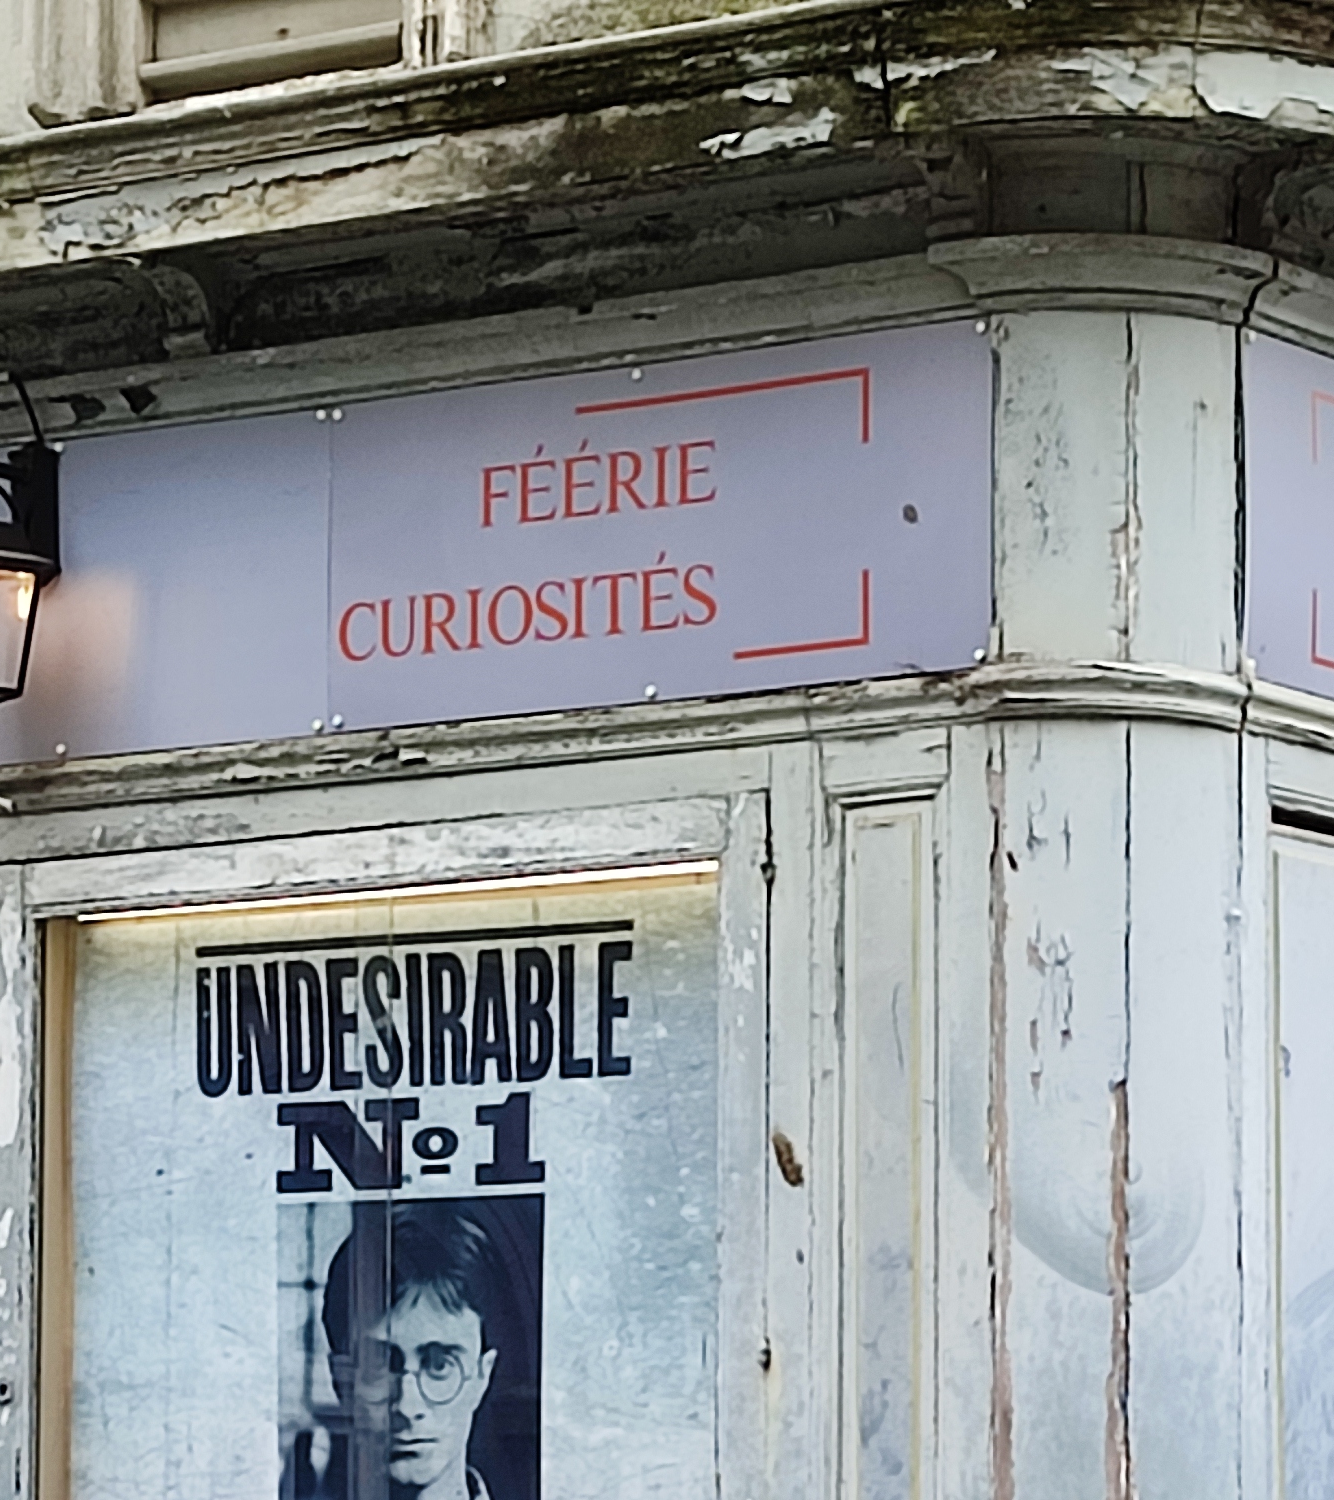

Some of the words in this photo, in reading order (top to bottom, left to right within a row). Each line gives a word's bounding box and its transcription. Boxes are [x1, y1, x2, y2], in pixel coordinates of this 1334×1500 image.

[480, 438, 717, 527] FÉÉRIE
[338, 550, 718, 661] CURIOSITÉS
[196, 940, 634, 1098] UNDESIRABLE
